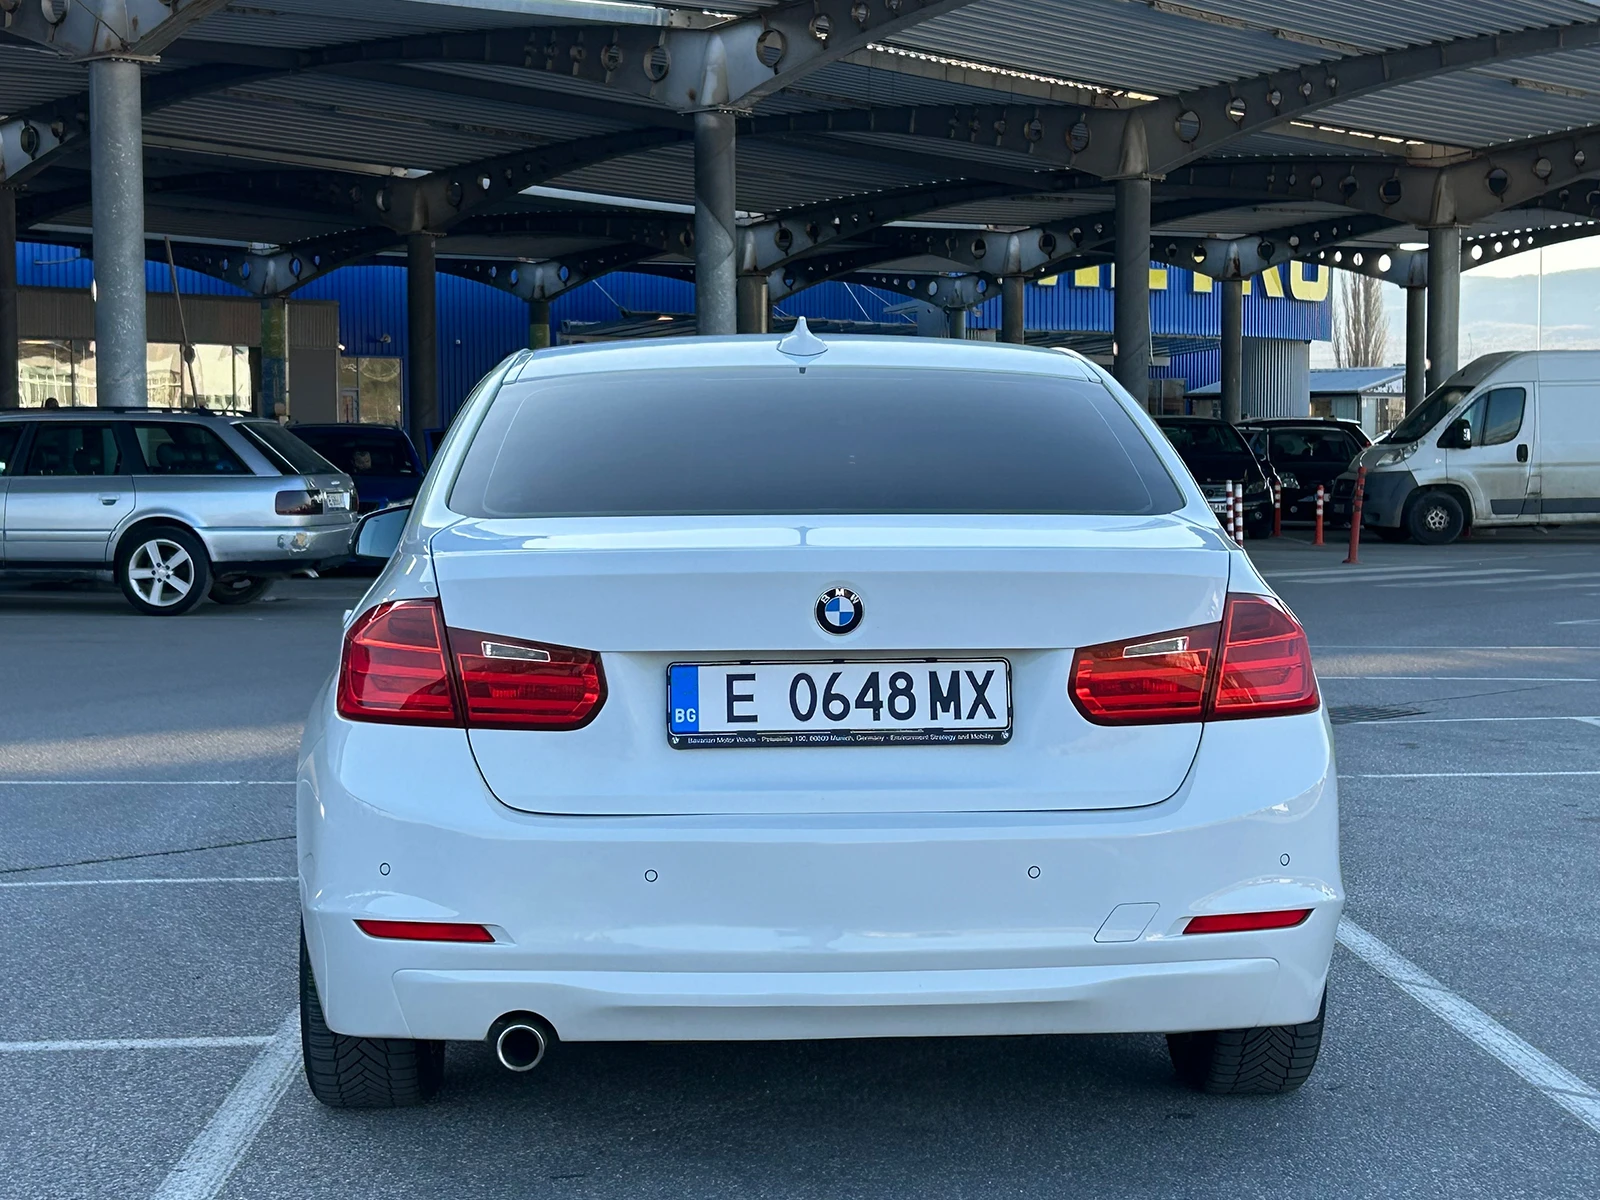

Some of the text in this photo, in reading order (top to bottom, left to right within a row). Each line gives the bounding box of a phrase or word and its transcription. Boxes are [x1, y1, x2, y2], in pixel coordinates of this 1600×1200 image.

[820, 588, 860, 604] BMW
[726, 669, 997, 723] E 0648 MX
[675, 708, 697, 723] BG
[687, 736, 716, 744] Bavarian
[716, 736, 735, 744] Motor
[856, 734, 885, 742] Germany
[970, 733, 994, 741] Mobility
